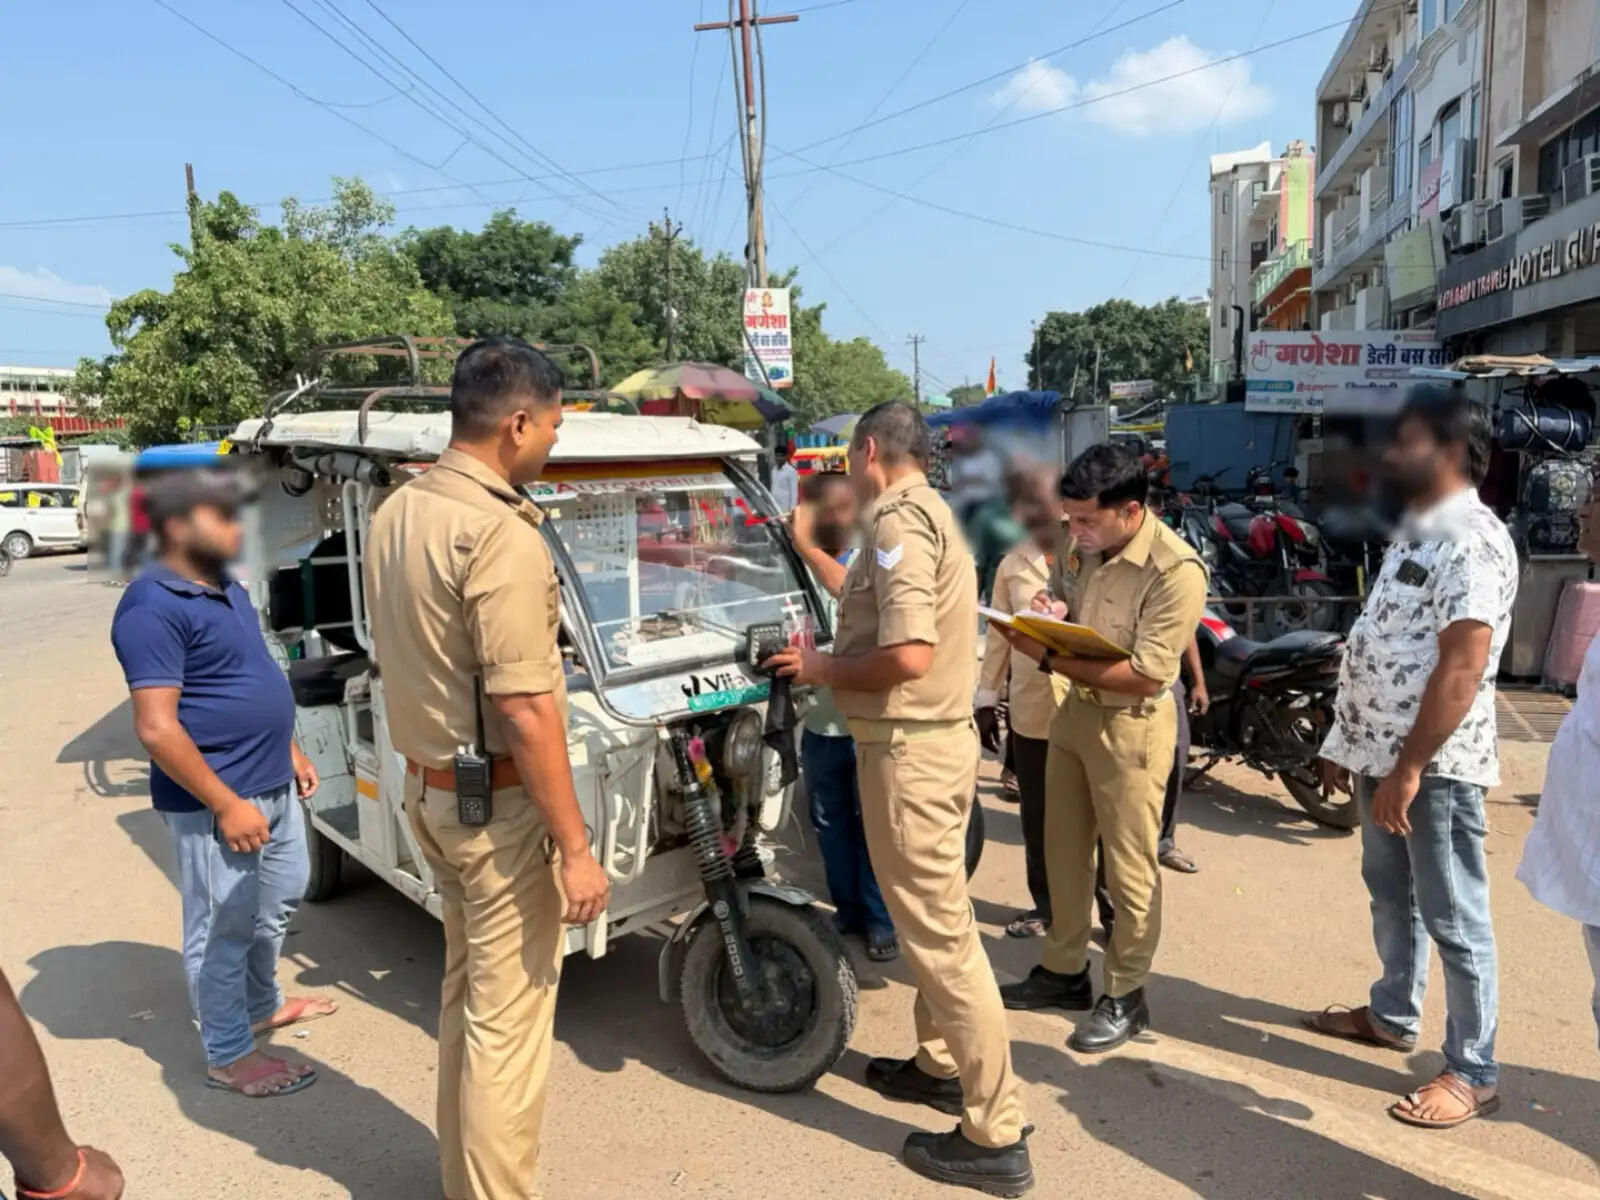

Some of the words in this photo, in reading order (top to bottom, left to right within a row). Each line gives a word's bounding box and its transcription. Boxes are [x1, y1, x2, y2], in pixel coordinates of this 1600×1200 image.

[1509, 241, 1561, 290] HOTEL
[744, 308, 788, 329] गणेशा
[1275, 333, 1362, 366] गणेशा
[1367, 343, 1397, 365] डेली
[1401, 347, 1426, 365] बस
